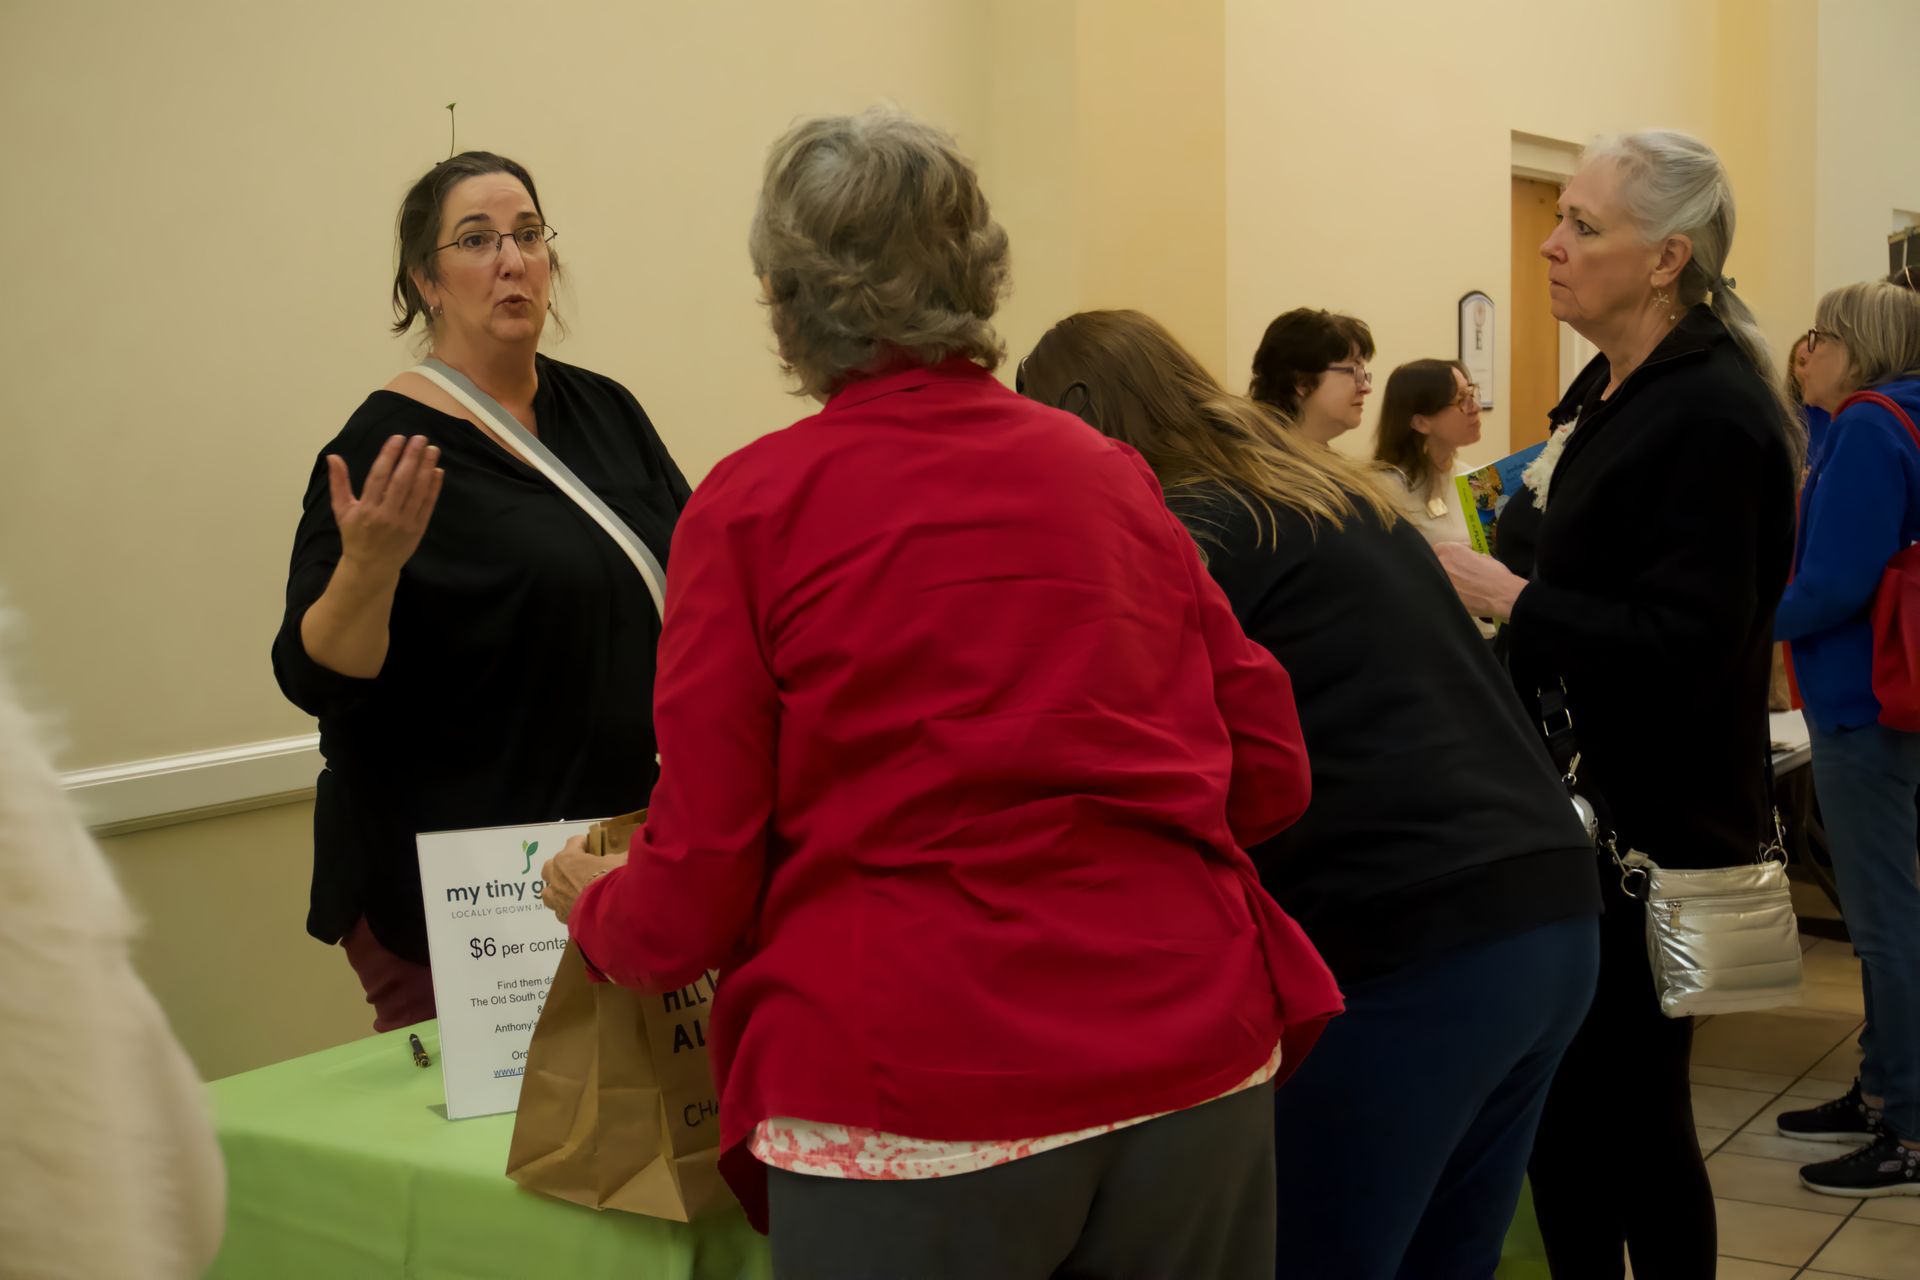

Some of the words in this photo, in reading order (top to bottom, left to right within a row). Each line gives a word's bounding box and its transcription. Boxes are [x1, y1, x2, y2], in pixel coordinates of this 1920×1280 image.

[446, 886, 480, 905] my
[485, 880, 526, 901] tiny
[531, 880, 550, 900] g
[451, 908, 492, 919] LOCALLY
[495, 904, 532, 915] GROWN
[470, 937, 497, 960] $6
[502, 943, 525, 958] per
[529, 936, 569, 952] conta
[497, 980, 518, 990] Find
[519, 978, 543, 988] them
[470, 998, 489, 1007] The
[490, 994, 507, 1005] Old
[509, 991, 536, 1003] South
